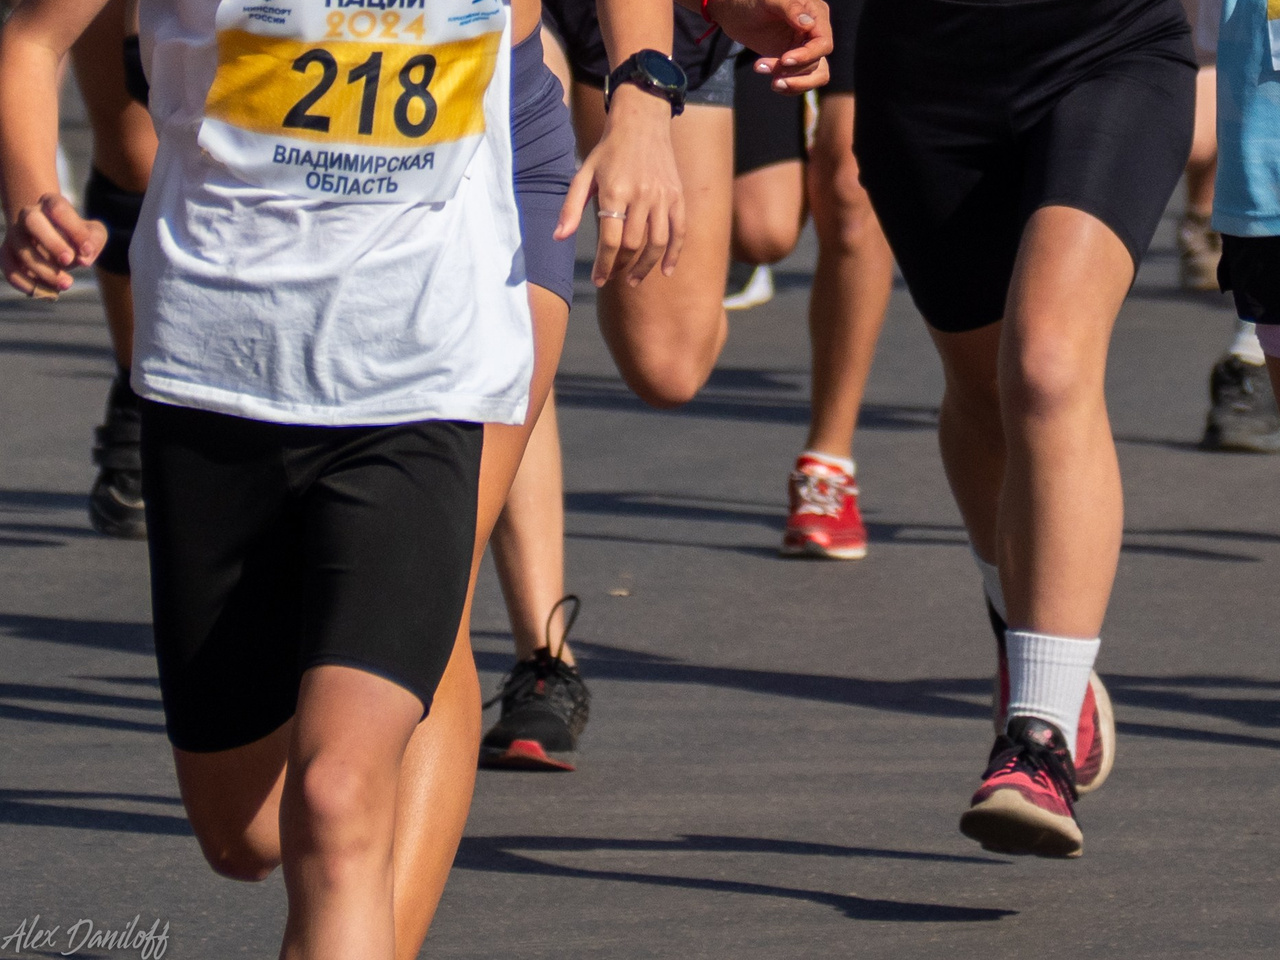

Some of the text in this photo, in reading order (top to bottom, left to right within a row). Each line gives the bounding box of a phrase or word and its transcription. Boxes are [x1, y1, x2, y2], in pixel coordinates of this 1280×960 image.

[323, 10, 426, 40] 2024
[282, 48, 438, 138] 218
[272, 145, 435, 174] ВЛАДИМИРСКАЯ
[305, 172, 399, 196] ОБЛАСТЬ
